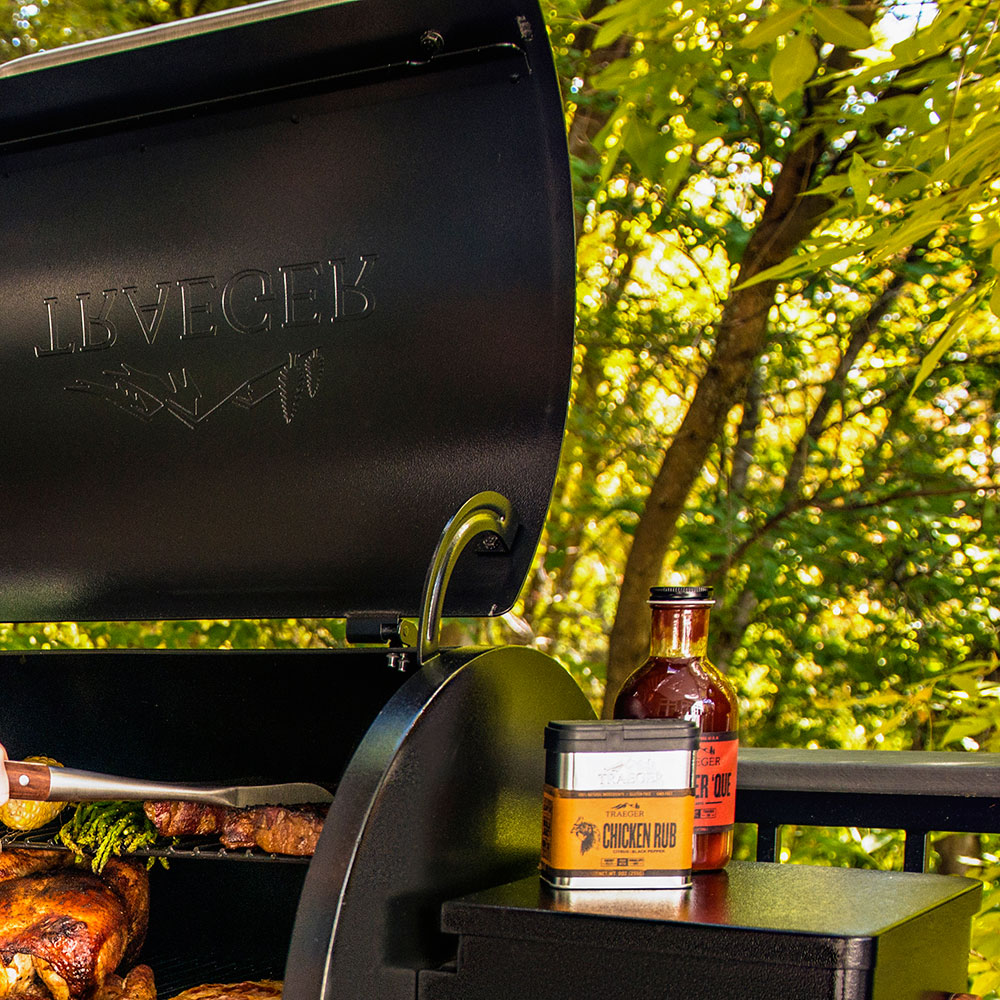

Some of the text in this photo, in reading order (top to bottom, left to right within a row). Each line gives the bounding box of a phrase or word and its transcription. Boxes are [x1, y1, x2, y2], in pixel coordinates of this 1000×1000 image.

[696, 757, 720, 767] EGER
[695, 774, 708, 798] ER
[606, 810, 645, 818] TRAEGER
[602, 822, 677, 849] CHICKEN RUB
